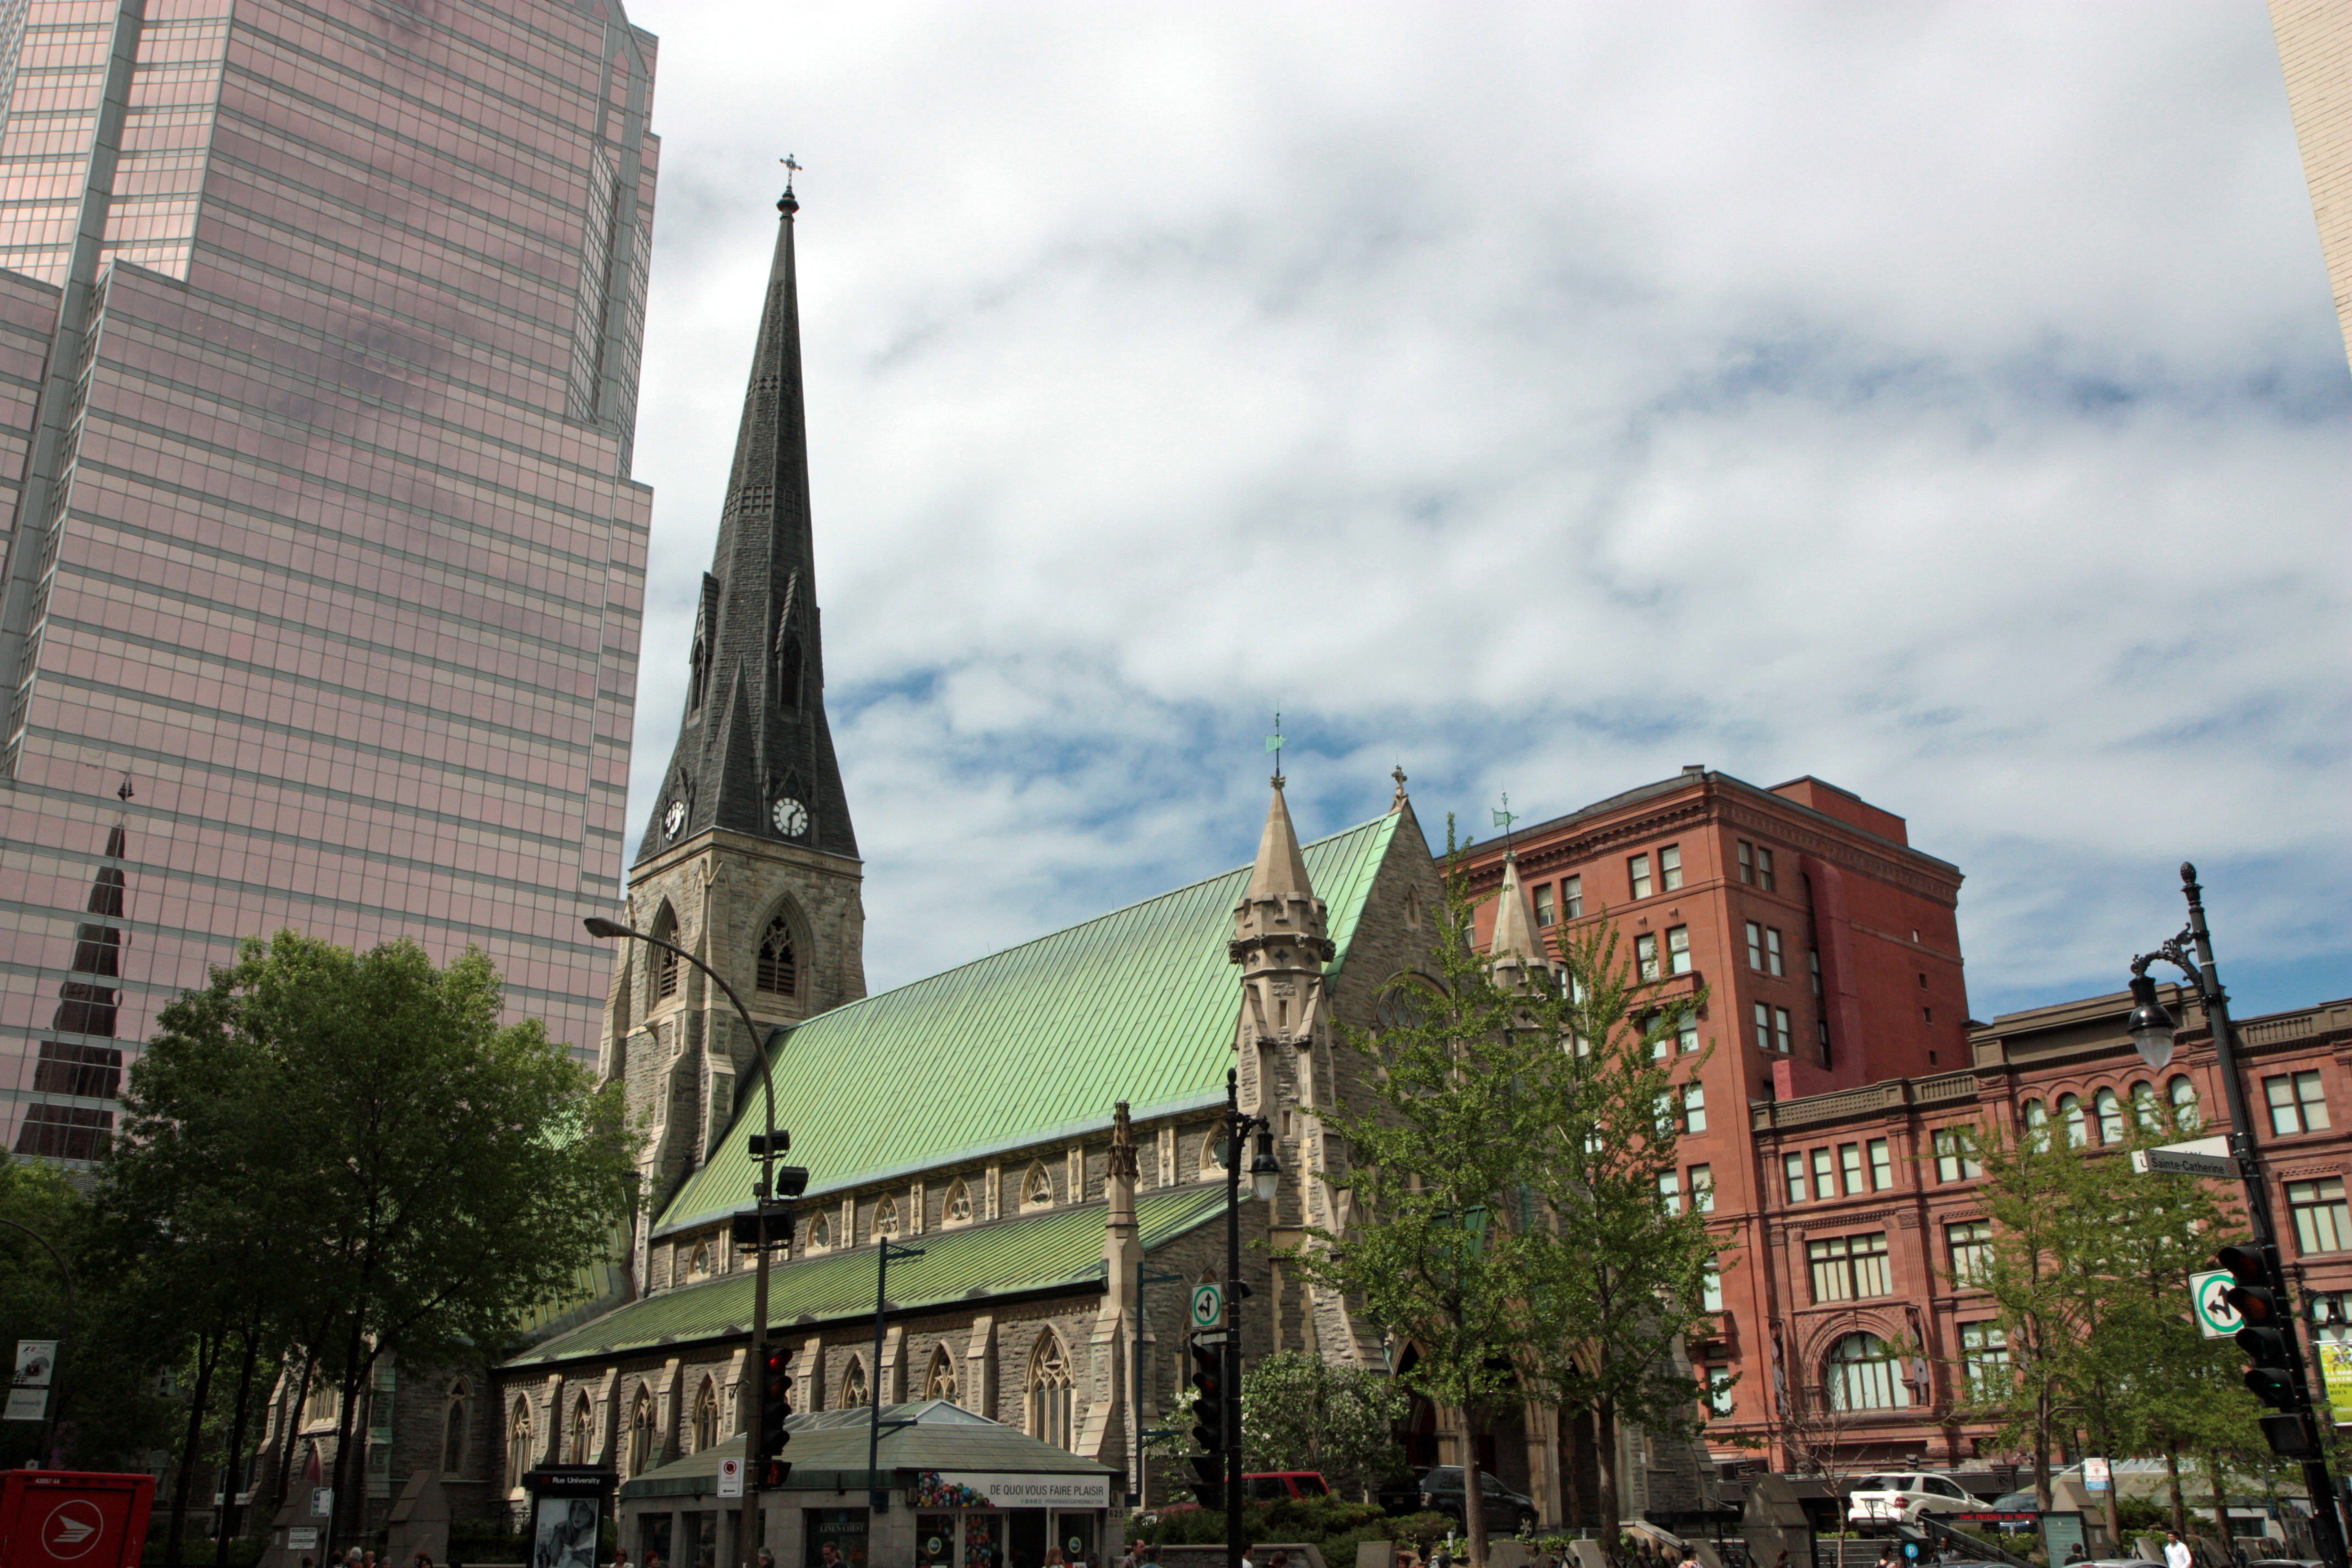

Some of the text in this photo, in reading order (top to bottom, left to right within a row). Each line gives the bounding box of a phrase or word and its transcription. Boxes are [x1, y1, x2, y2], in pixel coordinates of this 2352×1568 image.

[2151, 1157, 2224, 1174] Sainte-Catherine
[990, 1485, 1103, 1496] DE QUOI VOUS FAIRE PLAISIR
[1109, 1510, 1123, 1518] 625
